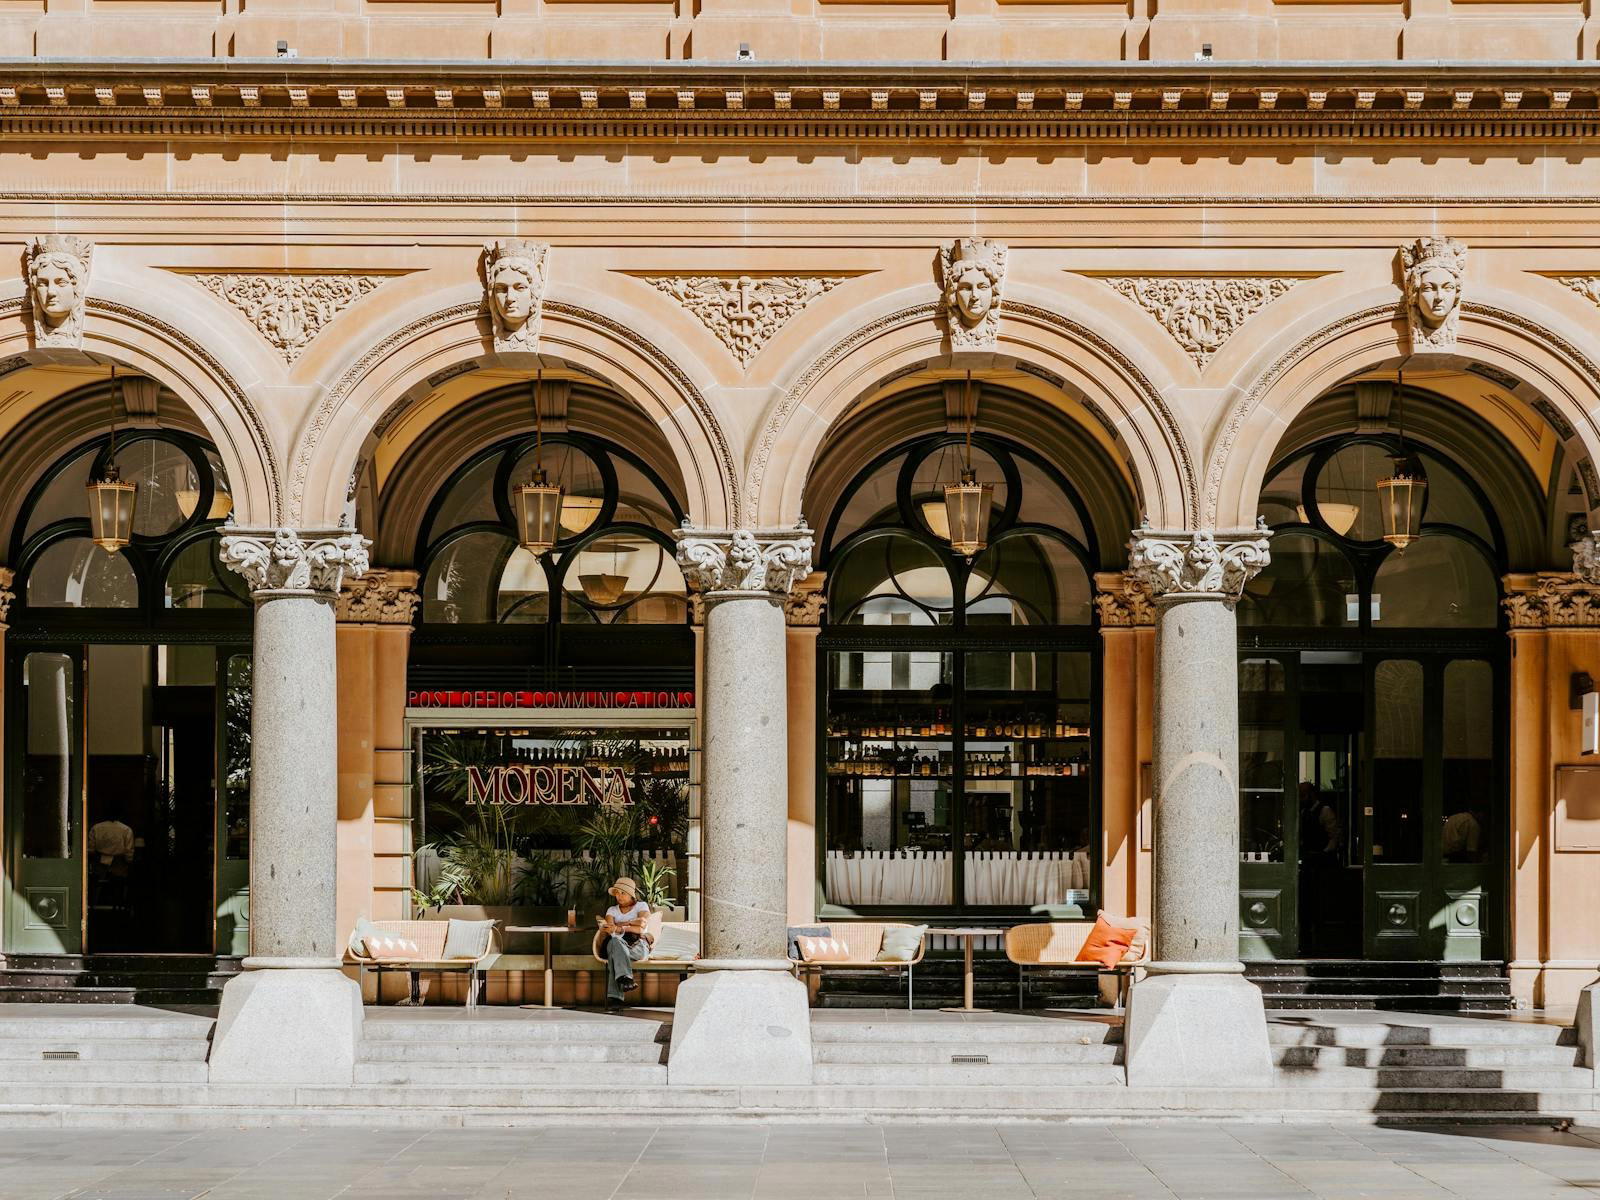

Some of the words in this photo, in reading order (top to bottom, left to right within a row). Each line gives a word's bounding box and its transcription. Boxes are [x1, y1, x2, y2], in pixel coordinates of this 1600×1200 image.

[409, 691, 454, 708] POST
[462, 691, 525, 708] OFFICE
[533, 691, 693, 708] COMMUNICATIONS
[465, 766, 635, 806] MORENA
